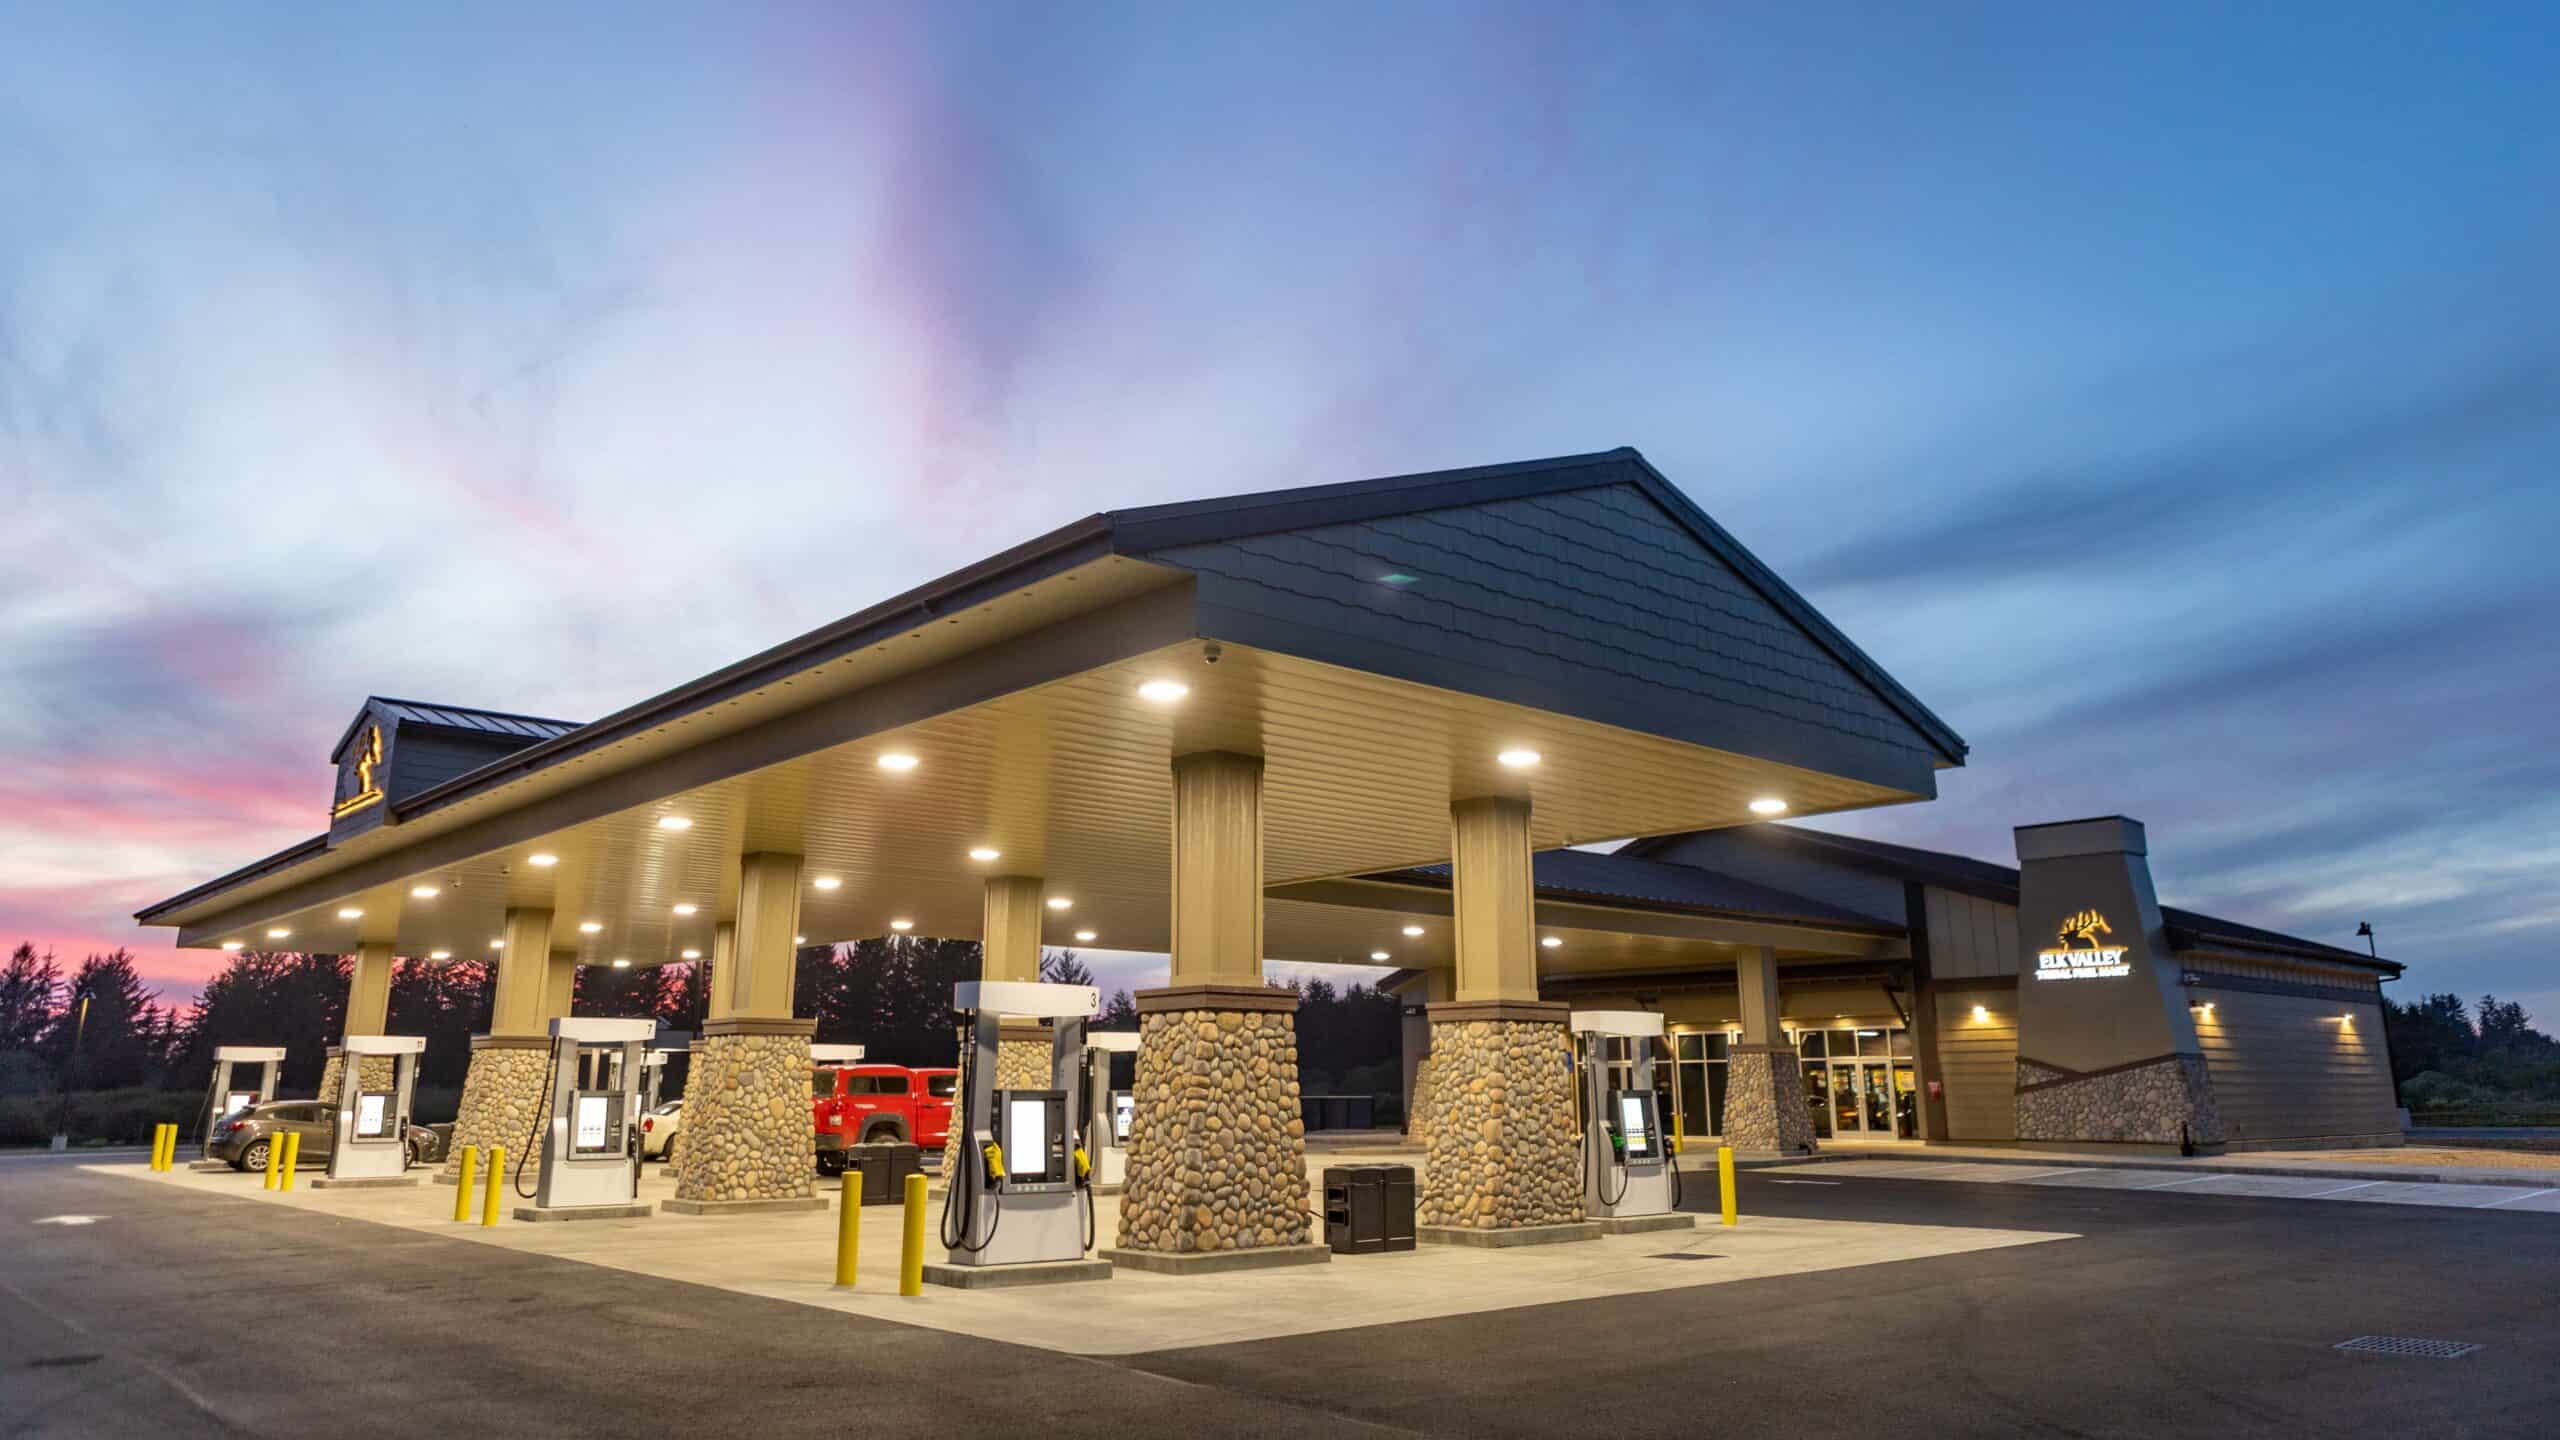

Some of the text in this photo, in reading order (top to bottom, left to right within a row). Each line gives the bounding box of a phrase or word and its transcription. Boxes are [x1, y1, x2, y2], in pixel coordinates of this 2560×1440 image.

[2039, 950, 2122, 969] ELK VALLEY
[1090, 992, 1097, 1009] 3
[647, 1023, 653, 1035] 7
